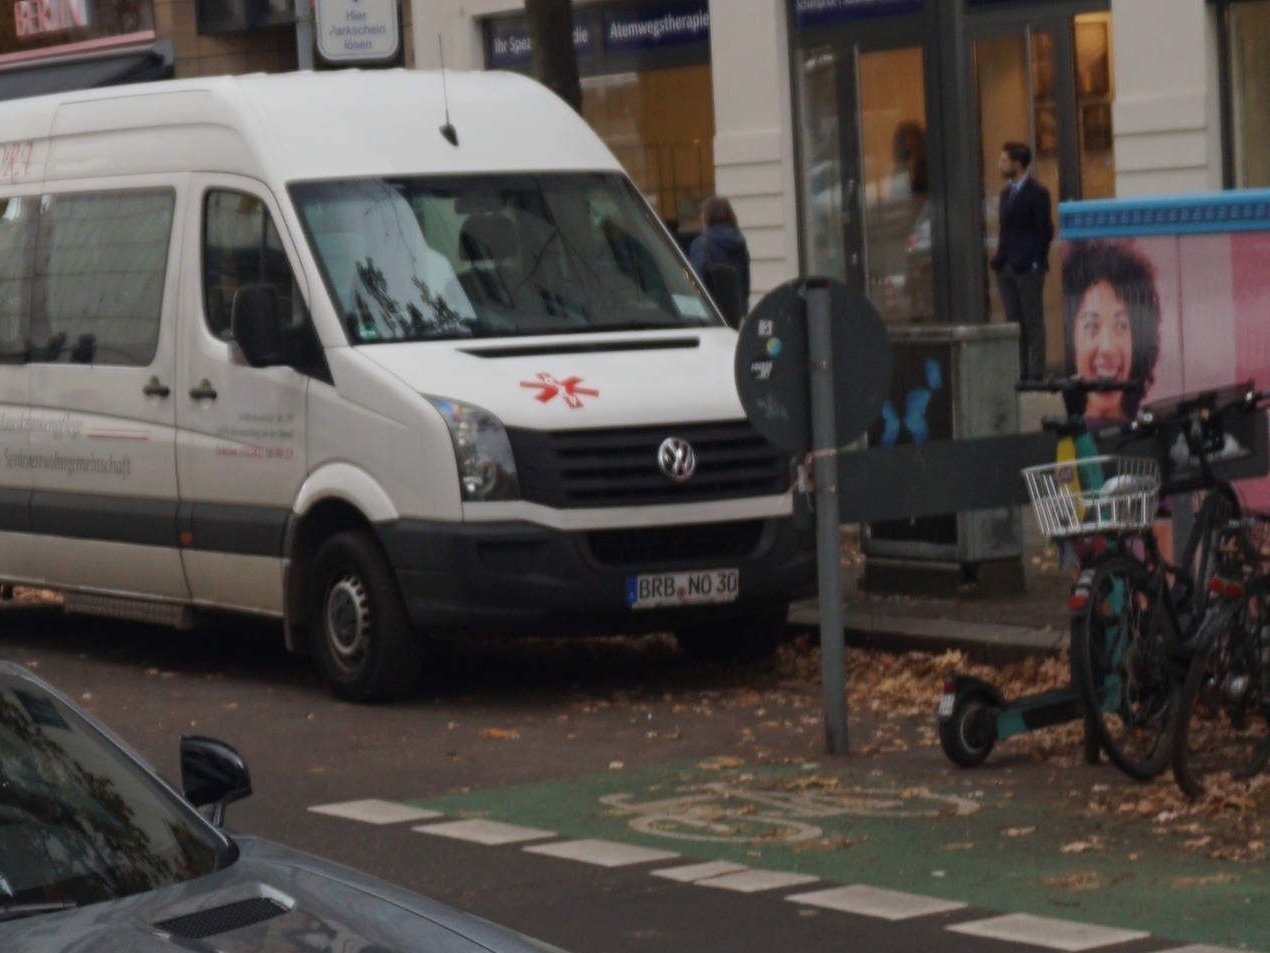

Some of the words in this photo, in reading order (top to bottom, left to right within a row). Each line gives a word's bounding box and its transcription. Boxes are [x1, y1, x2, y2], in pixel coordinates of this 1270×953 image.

[345, 10, 367, 20] Hier
[329, 24, 386, 36] Parkschein
[610, 10, 709, 42] Atemwegstherapie
[343, 40, 372, 50] lösen
[494, 38, 507, 54] Ihr
[638, 576, 676, 600] BRB
[688, 574, 712, 596] NO
[716, 572, 737, 593] 30
